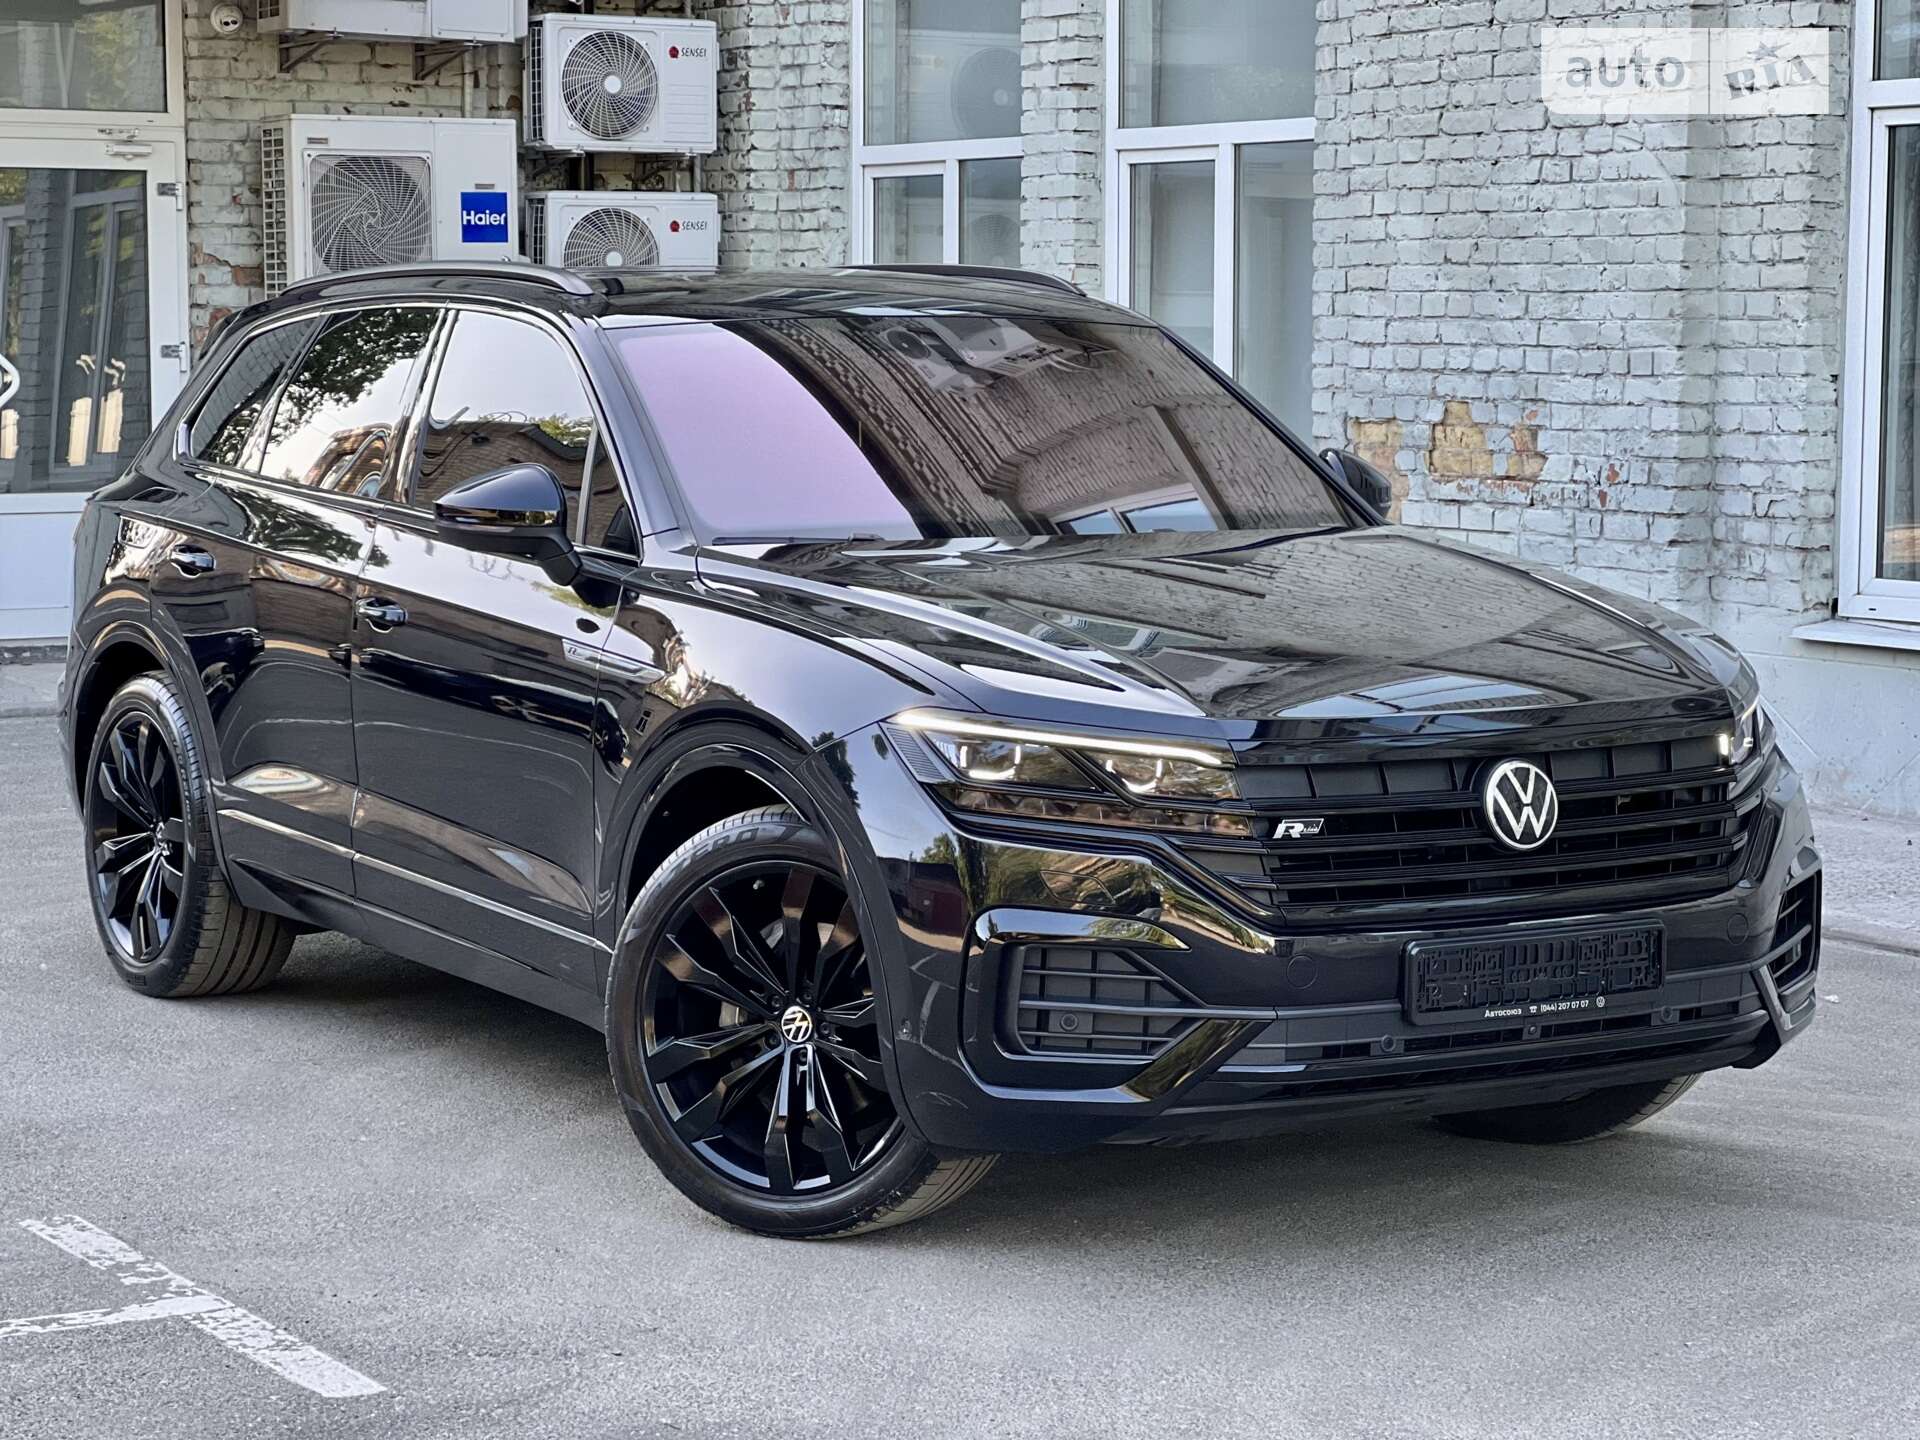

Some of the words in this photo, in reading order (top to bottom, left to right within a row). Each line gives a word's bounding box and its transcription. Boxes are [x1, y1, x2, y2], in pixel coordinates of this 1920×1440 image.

[681, 47, 707, 58] SENSEI
[462, 209, 506, 225] Haier
[682, 220, 708, 231] SENSEI
[1540, 1002, 1557, 1013] (044)
[1558, 1001, 1570, 1011] 207
[1571, 1000, 1579, 1009] 07
[1580, 999, 1589, 1008] 07
